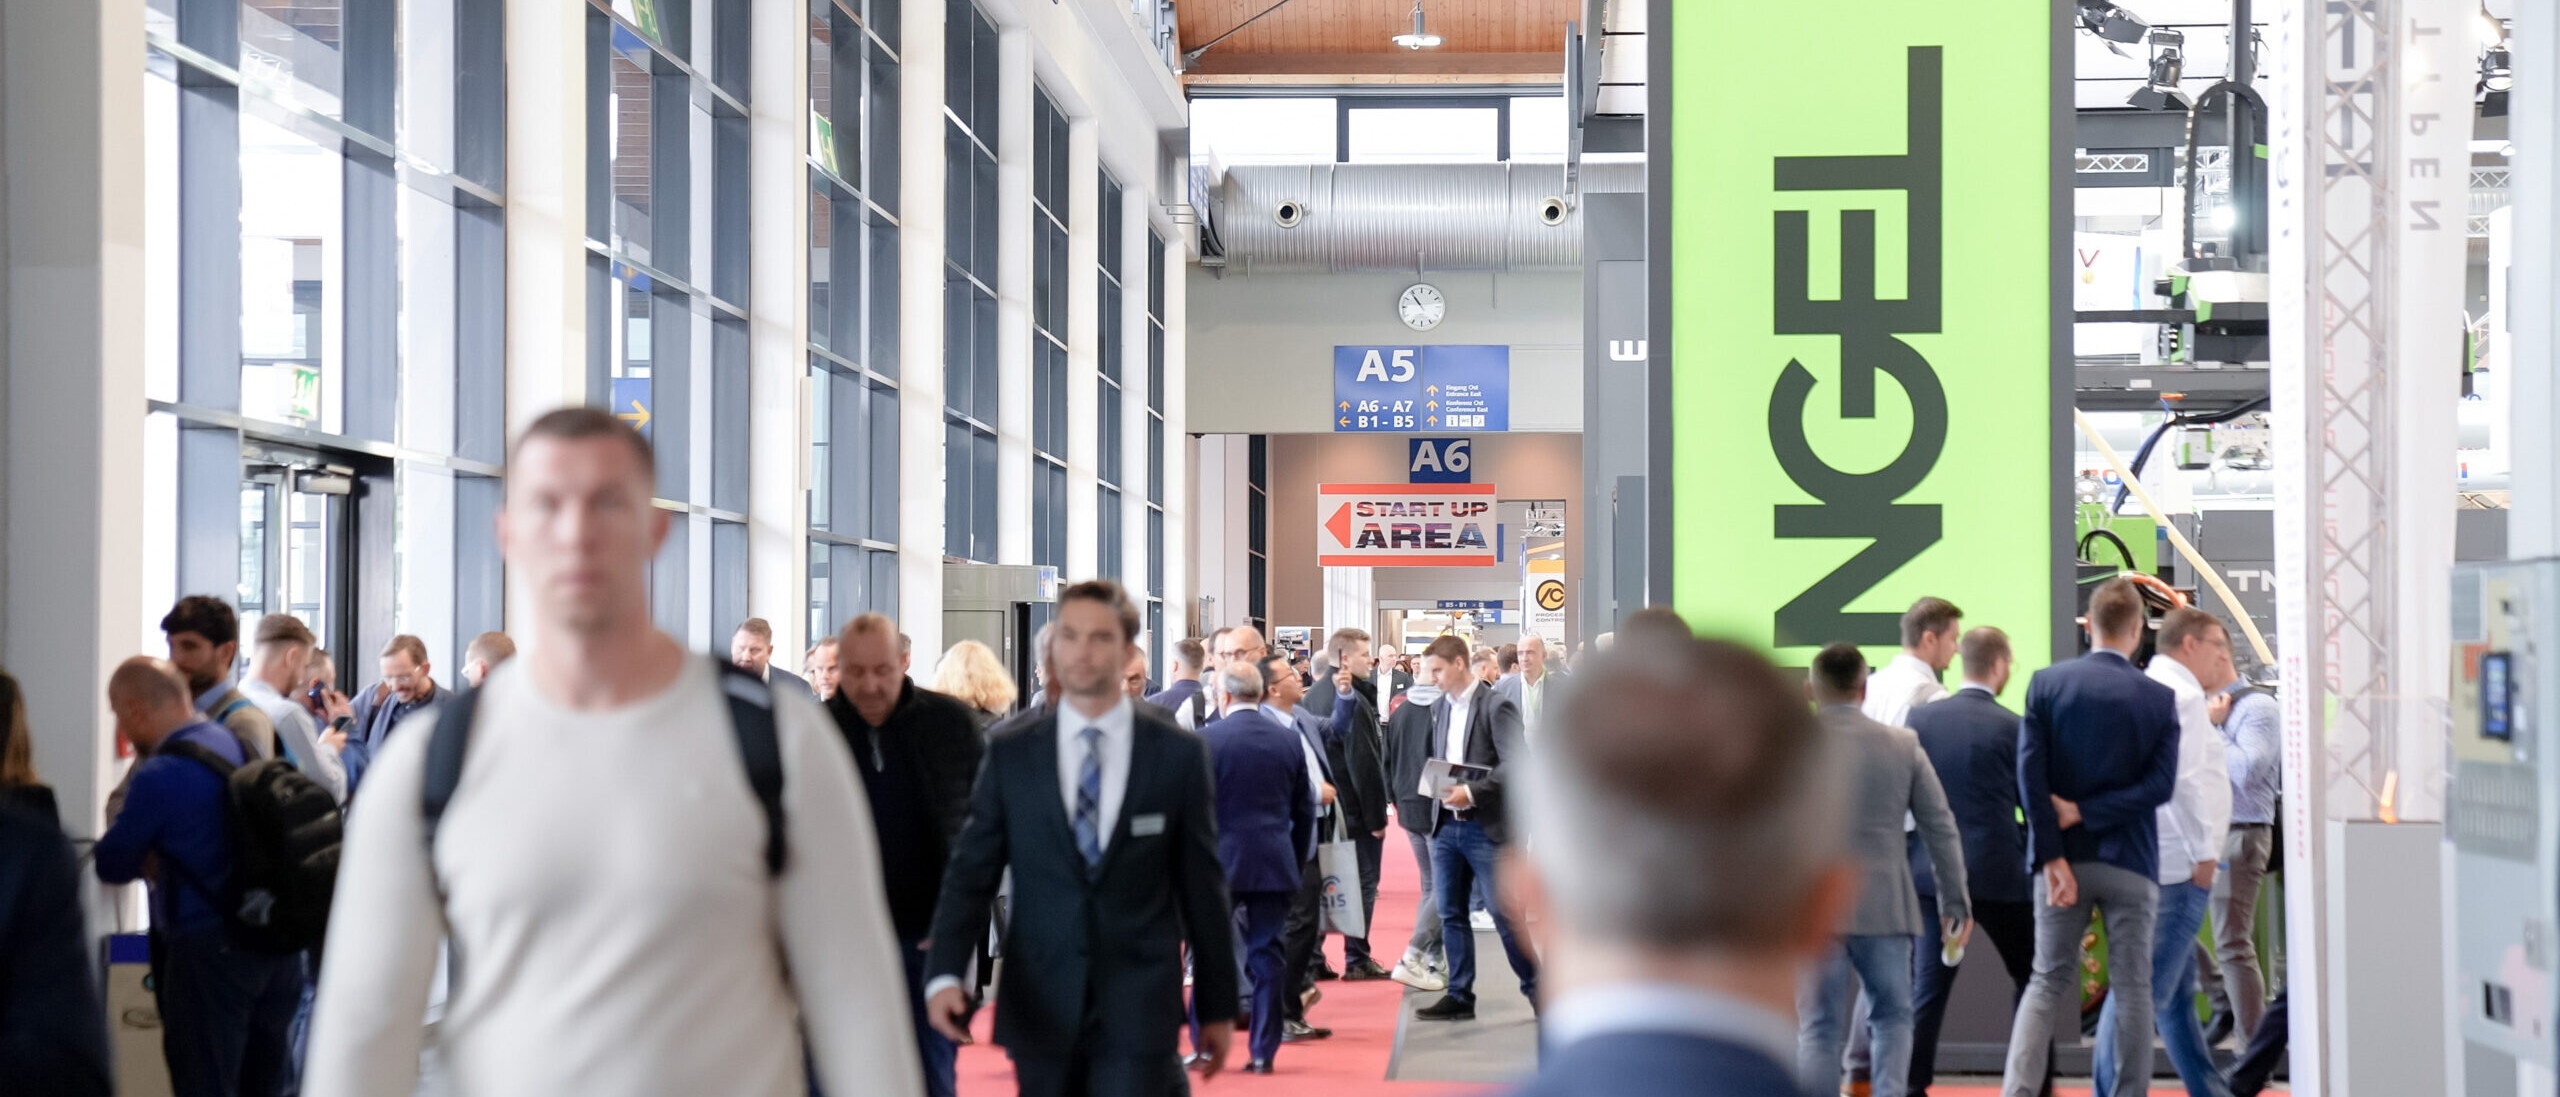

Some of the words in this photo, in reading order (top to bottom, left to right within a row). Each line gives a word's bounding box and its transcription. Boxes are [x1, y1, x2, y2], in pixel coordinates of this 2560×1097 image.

[1356, 349, 1415, 382] A5
[1768, 45, 1948, 684] NGEL
[1357, 400, 1379, 412] A6
[1392, 400, 1414, 412] A7
[1358, 415, 1378, 428] B1
[1393, 415, 1414, 428] B5
[1411, 440, 1470, 473] A6
[1356, 501, 1444, 517] START
[1450, 501, 1489, 517] UP
[1355, 522, 1488, 548] AREA
